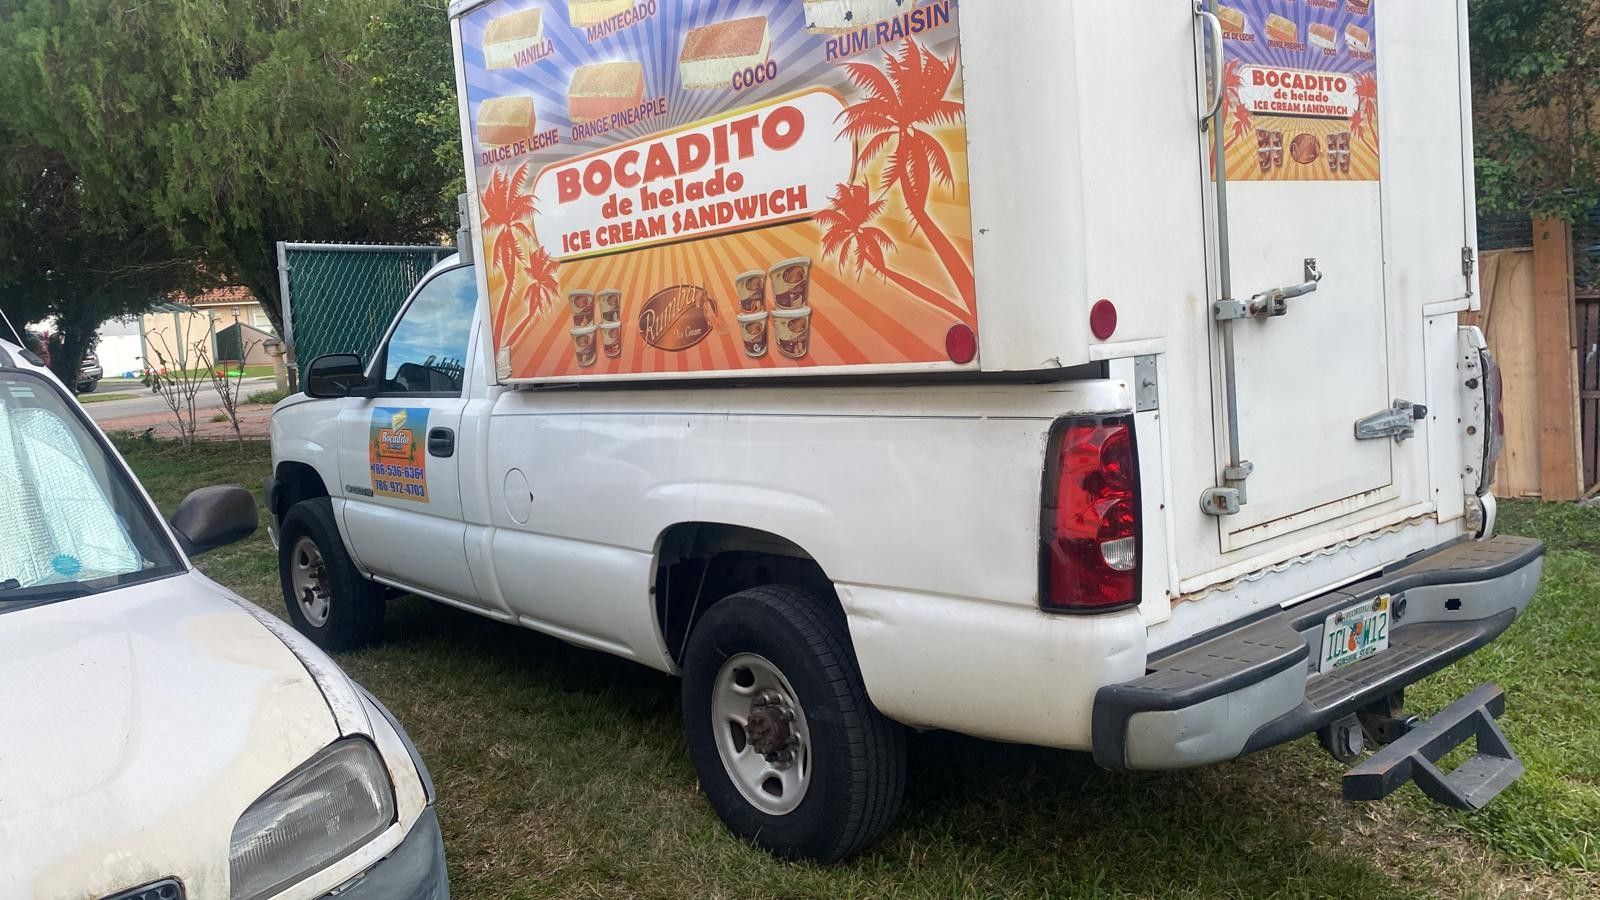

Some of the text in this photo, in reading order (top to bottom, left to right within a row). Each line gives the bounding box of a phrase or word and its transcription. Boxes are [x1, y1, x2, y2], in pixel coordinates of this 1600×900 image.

[587, 1, 657, 43] MANTECADO
[826, 1, 950, 61] RUM RAISIN
[514, 40, 555, 68] VANILLA
[732, 60, 777, 91] COCO
[1252, 69, 1347, 93] BOCADITO
[1273, 89, 1329, 102] de helado
[572, 98, 667, 141] ORANGE PINEAPPLE
[1254, 100, 1348, 115] ICE CREAM SANDWICH
[482, 129, 559, 166] DULCE DE LECHE
[556, 105, 805, 205] BOCADITO
[602, 167, 744, 220] de helado
[562, 184, 808, 253] ICE CREAM SANDWICH
[1327, 612, 1387, 661] ICL W12
